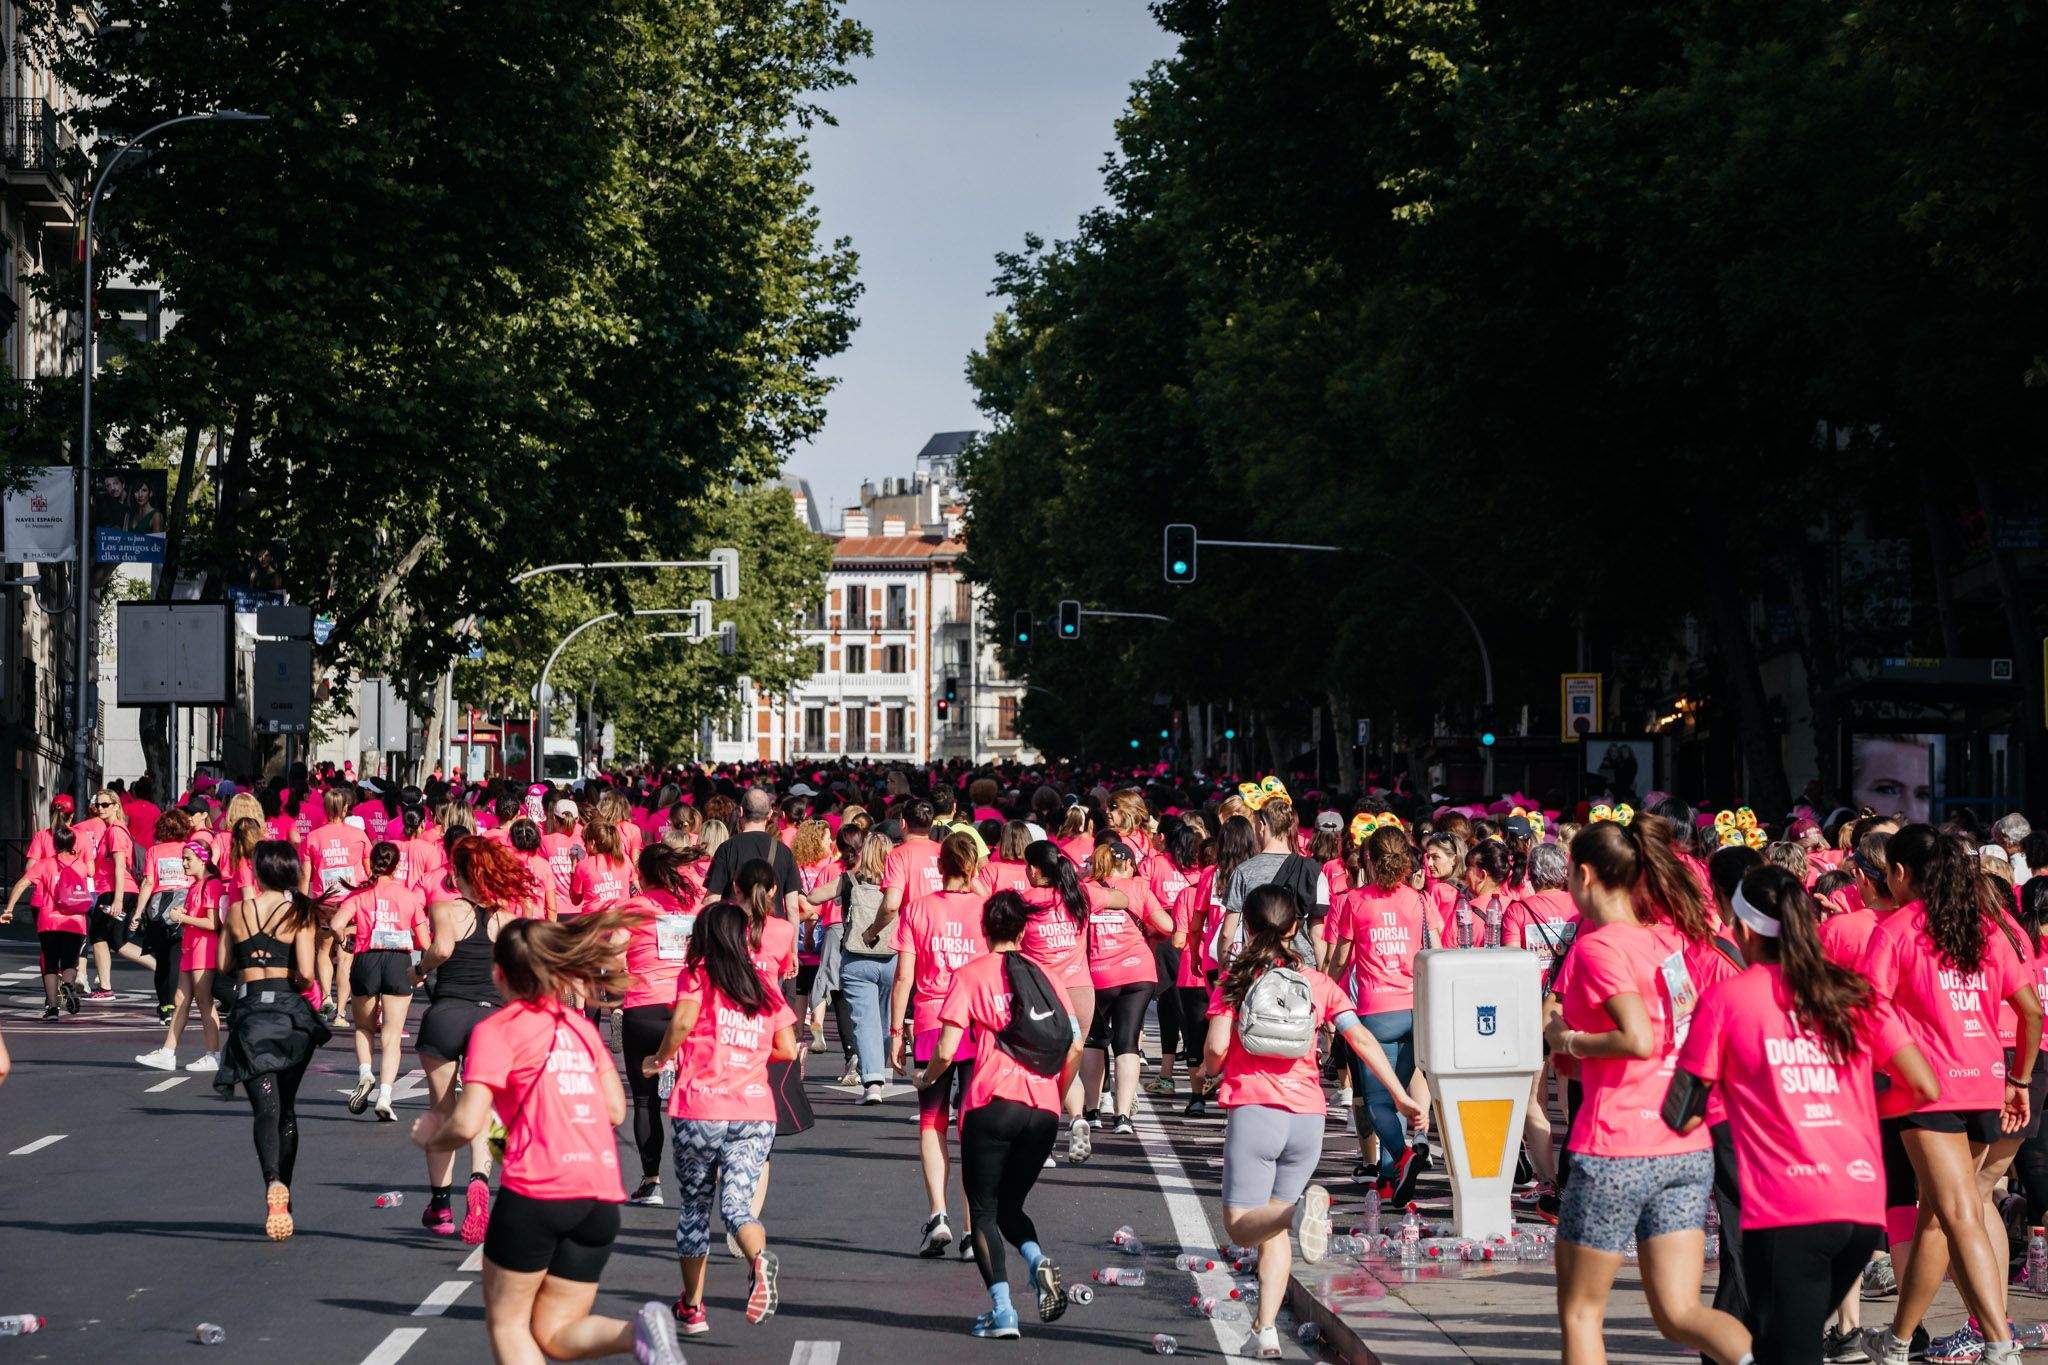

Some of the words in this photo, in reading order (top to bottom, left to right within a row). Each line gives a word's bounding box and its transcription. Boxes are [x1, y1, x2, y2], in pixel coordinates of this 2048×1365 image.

[37, 515, 64, 523] ESPAÑOL
[101, 542, 118, 551] Los
[119, 543, 150, 555] amigos
[151, 543, 161, 553] de
[101, 551, 120, 561] ellos
[122, 551, 138, 561] dos
[329, 839, 341, 847] TU
[322, 847, 350, 858] DORSAL
[557, 847, 568, 856] TU
[326, 856, 348, 866] SUMA
[602, 872, 614, 882] TU
[593, 881, 623, 894] DORSAL
[1012, 880, 1026, 891] TU
[599, 890, 621, 902] SUMA
[377, 899, 389, 910] TU
[1382, 911, 1396, 926] TU
[944, 921, 962, 937] TU
[1096, 923, 1124, 937] SUMA
[1369, 926, 1411, 942] DORSAL
[931, 936, 976, 954] DORSAL
[1046, 934, 1077, 949] SUMA
[1376, 940, 1407, 956] SUMA
[720, 1026, 759, 1050] SUMA
[1948, 1068, 1981, 1079] OYSHO
[1779, 1065, 1841, 1095] SUMA
[1640, 1109, 1660, 1120] OYS
